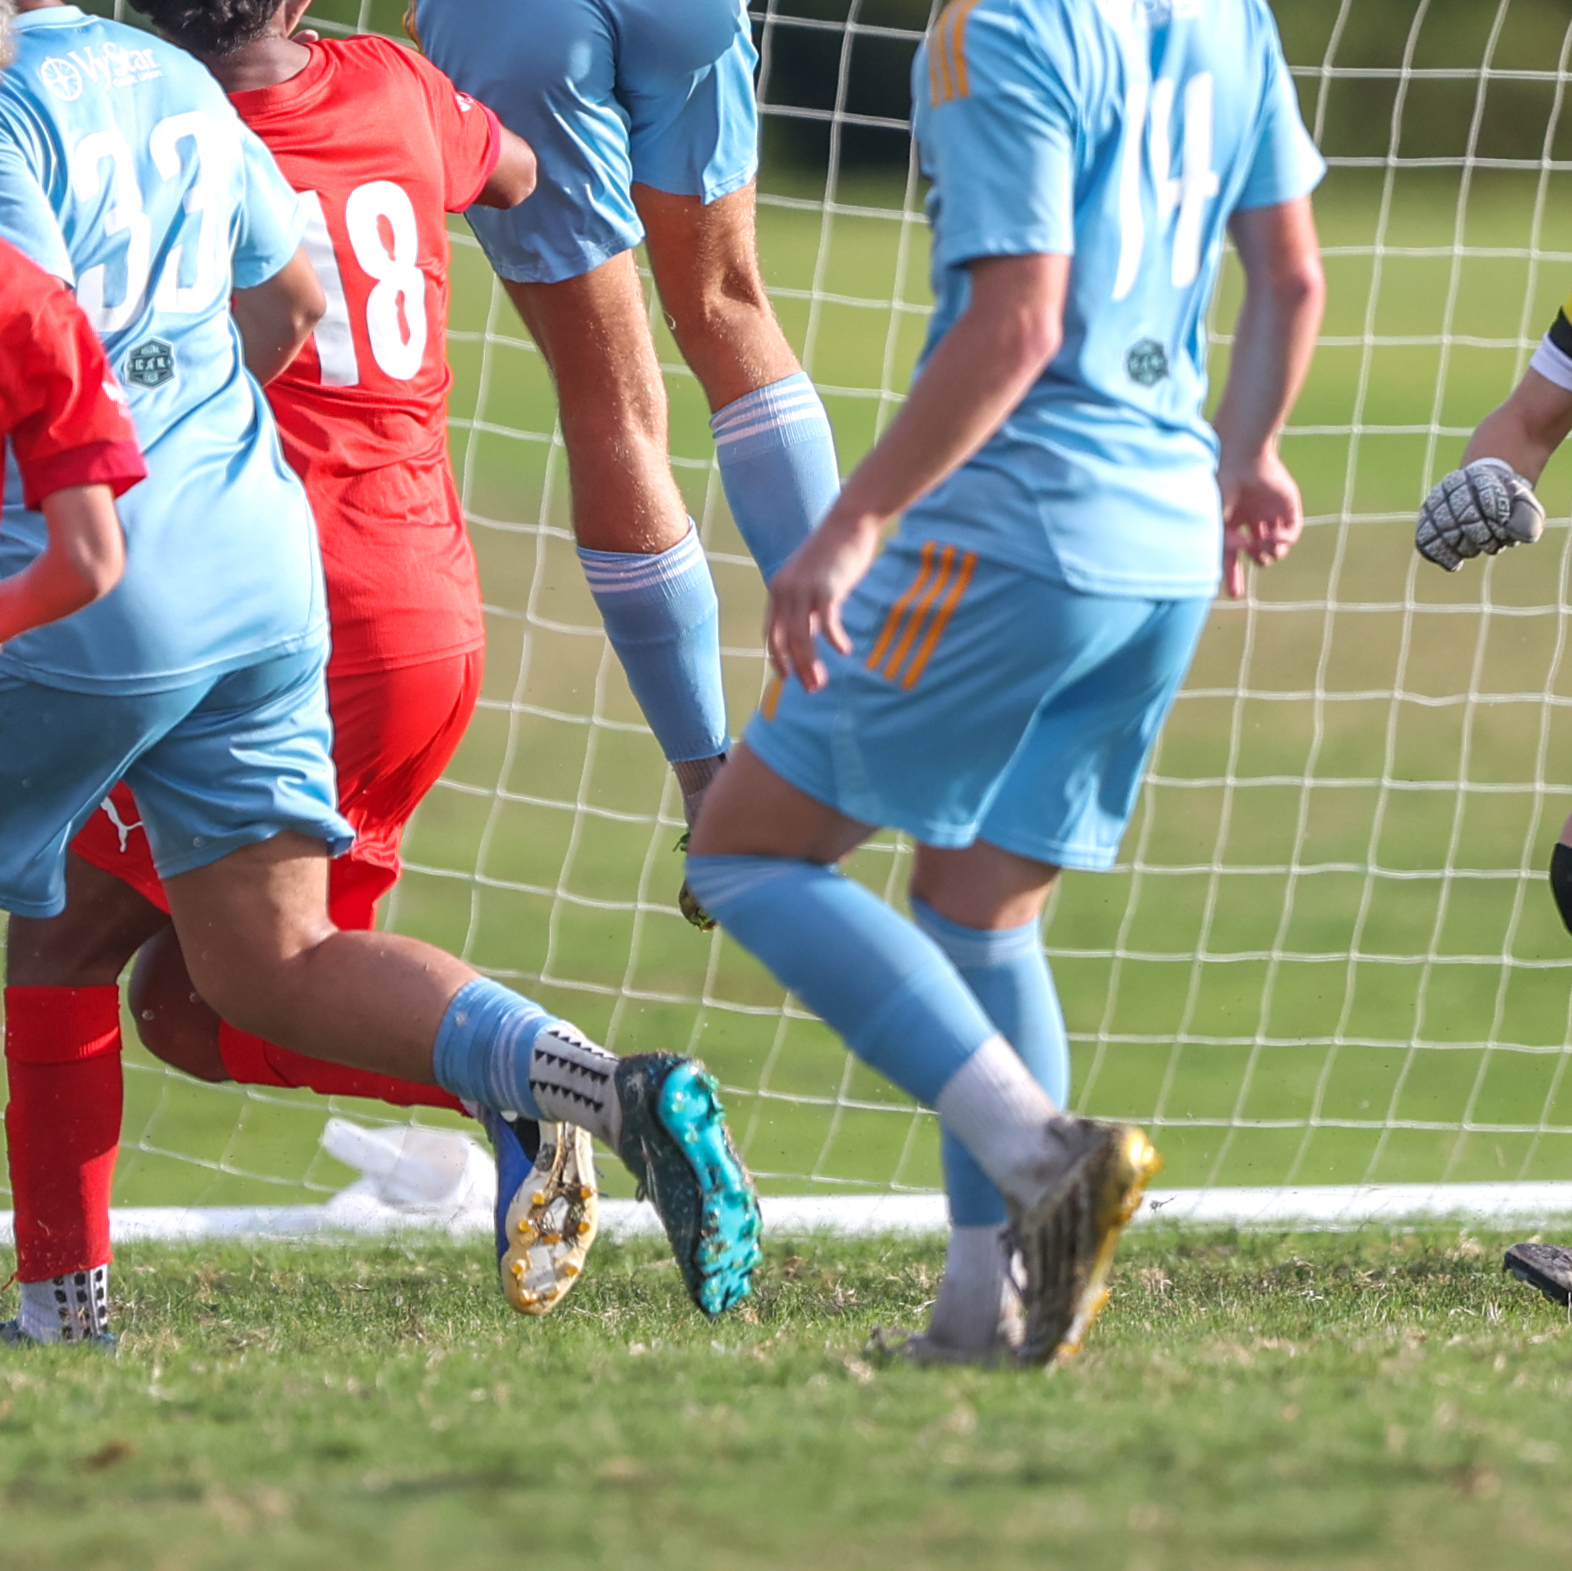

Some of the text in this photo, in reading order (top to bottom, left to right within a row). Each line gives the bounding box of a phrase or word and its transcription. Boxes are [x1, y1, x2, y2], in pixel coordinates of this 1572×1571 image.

[67, 42, 159, 89] VyStar
[74, 110, 216, 333] 33
[297, 180, 427, 386] 18
[1111, 71, 1220, 302] 14
